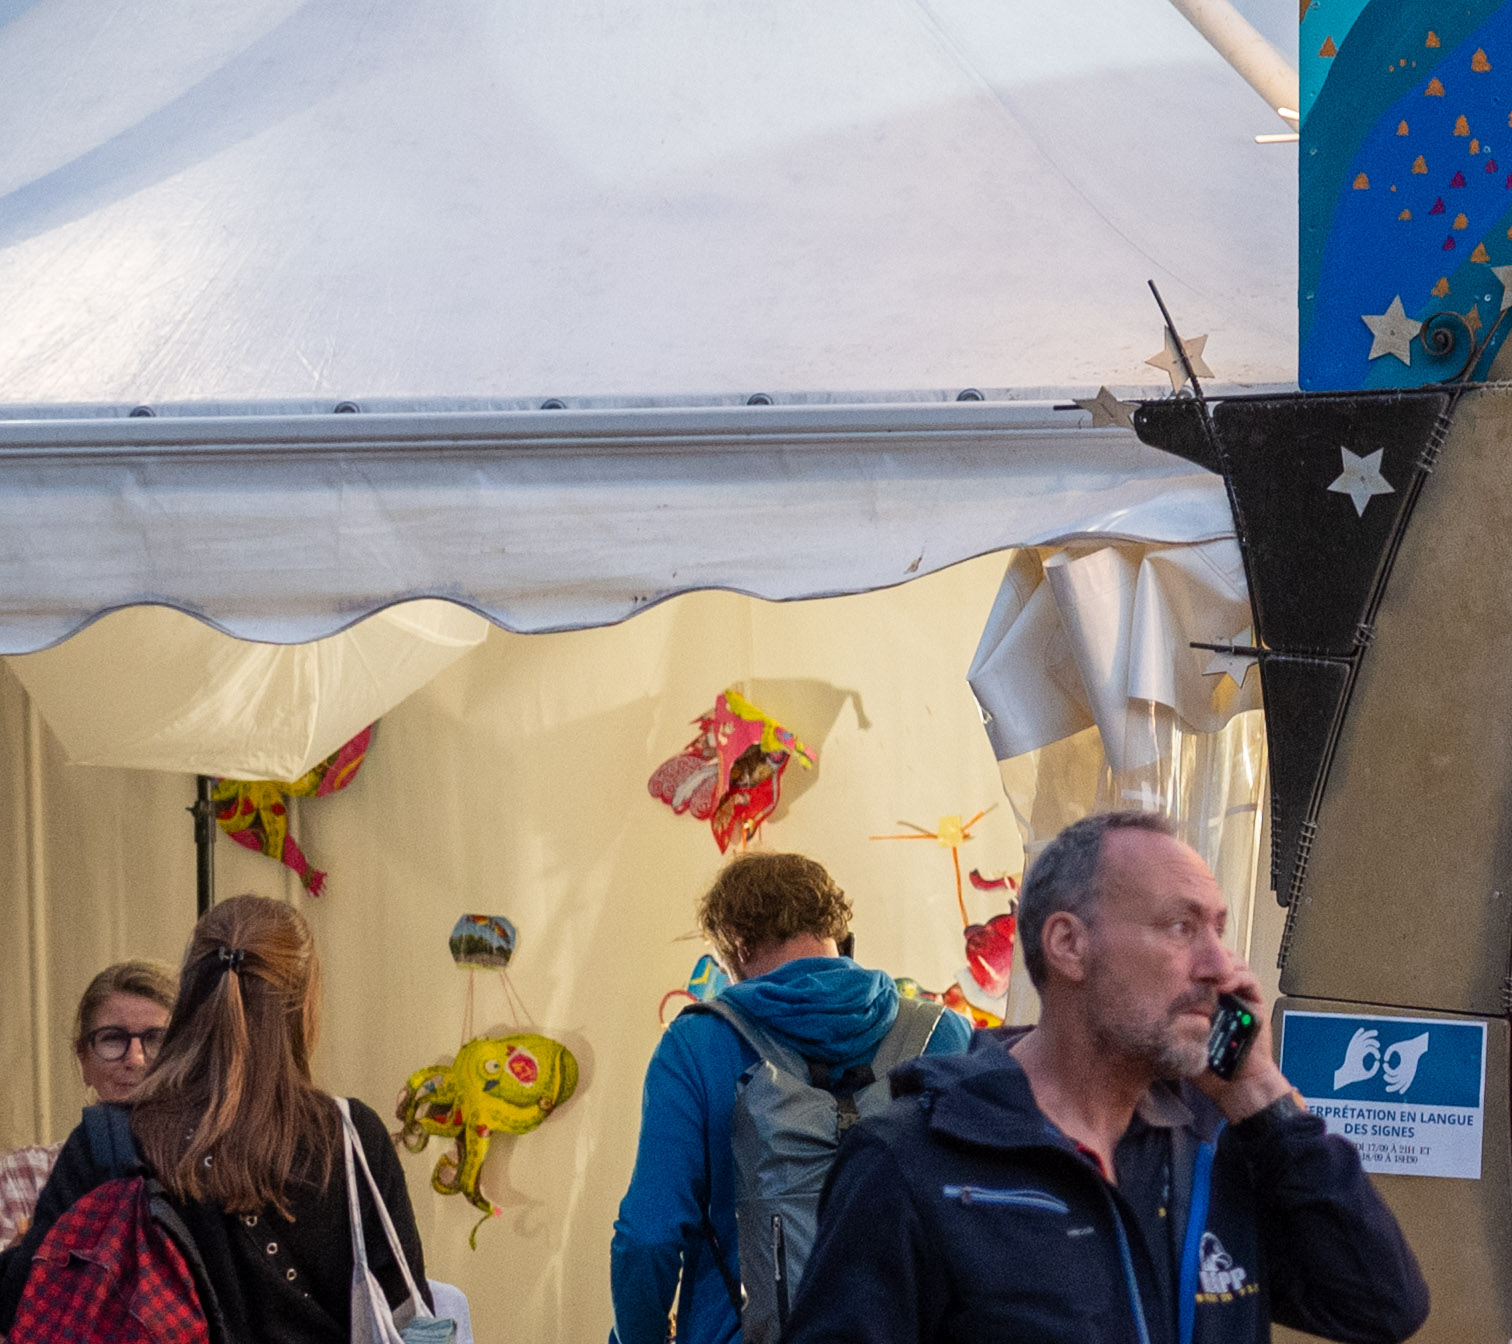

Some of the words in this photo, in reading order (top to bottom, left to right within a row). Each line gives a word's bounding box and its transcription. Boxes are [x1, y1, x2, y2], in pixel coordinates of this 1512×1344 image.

[1309, 1104, 1396, 1122] ERPRÉTATION
[1400, 1111, 1417, 1123] EN
[1420, 1112, 1474, 1126] LANGUE
[1344, 1123, 1368, 1135] DES
[1371, 1124, 1415, 1138] SIGNES
